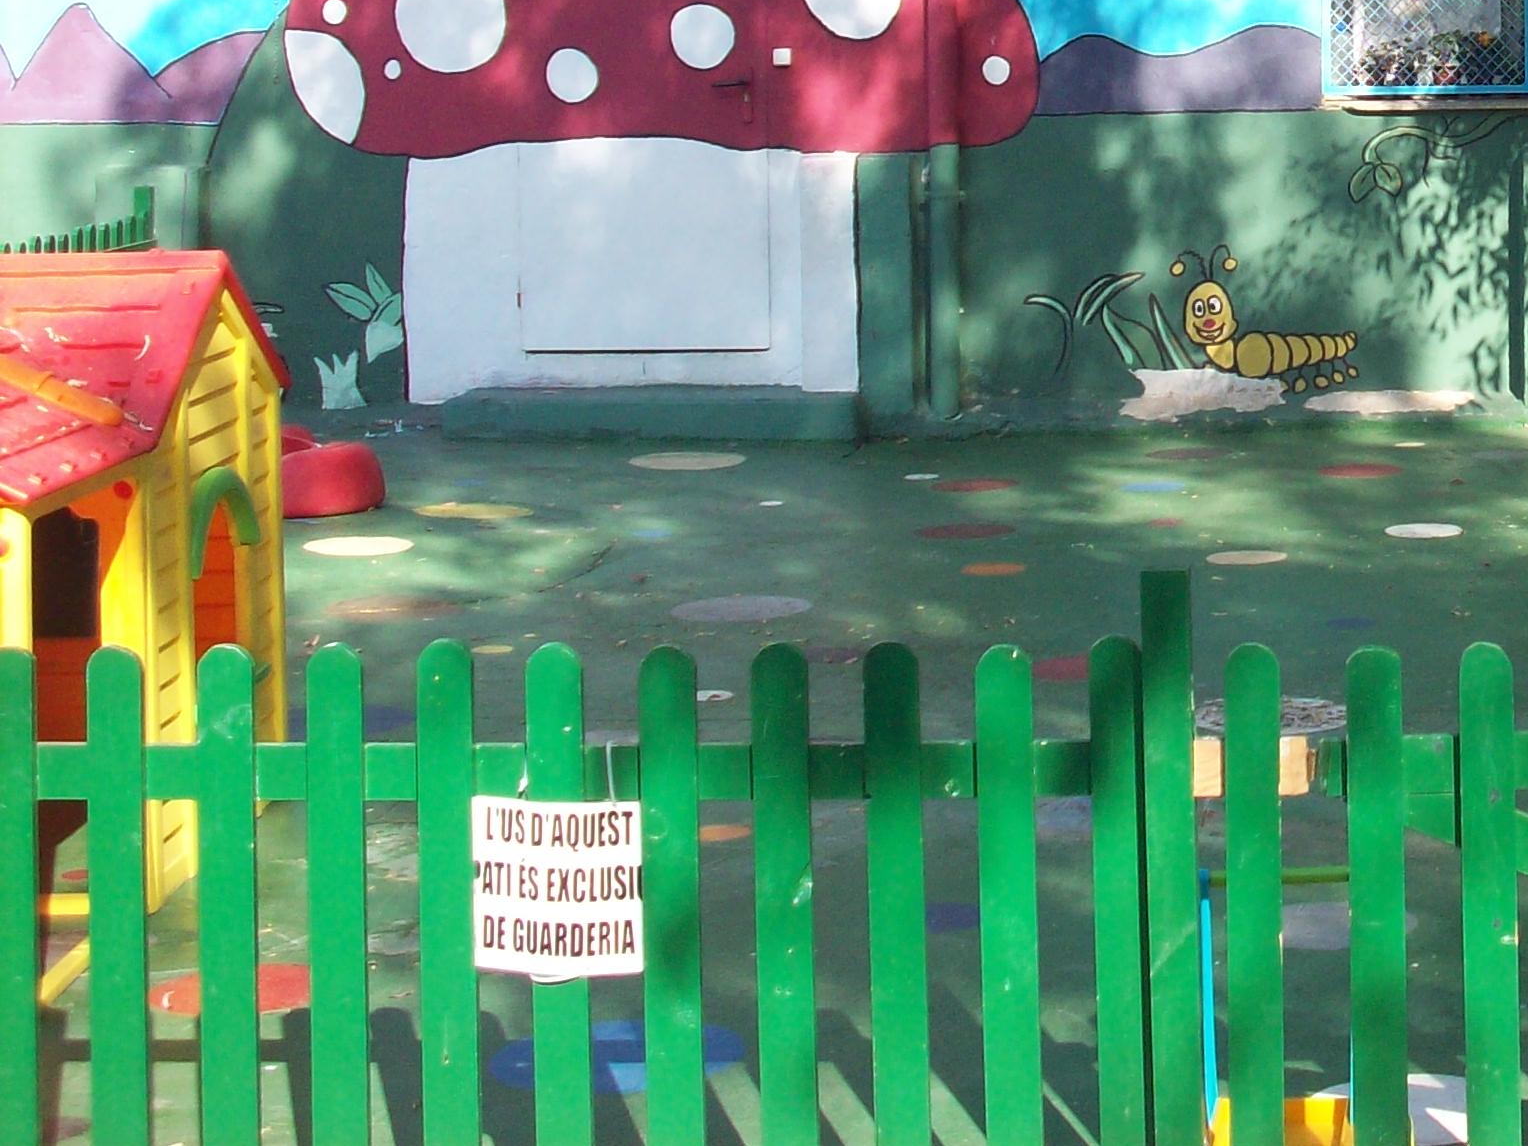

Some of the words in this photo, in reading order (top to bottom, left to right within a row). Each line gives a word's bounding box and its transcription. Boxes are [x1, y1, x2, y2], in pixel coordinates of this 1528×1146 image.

[486, 806, 525, 844] L'US
[531, 811, 633, 852] D'AQUEST
[519, 857, 539, 901] ÉS
[483, 914, 506, 950] DE
[513, 918, 635, 957] GUARDERIA
